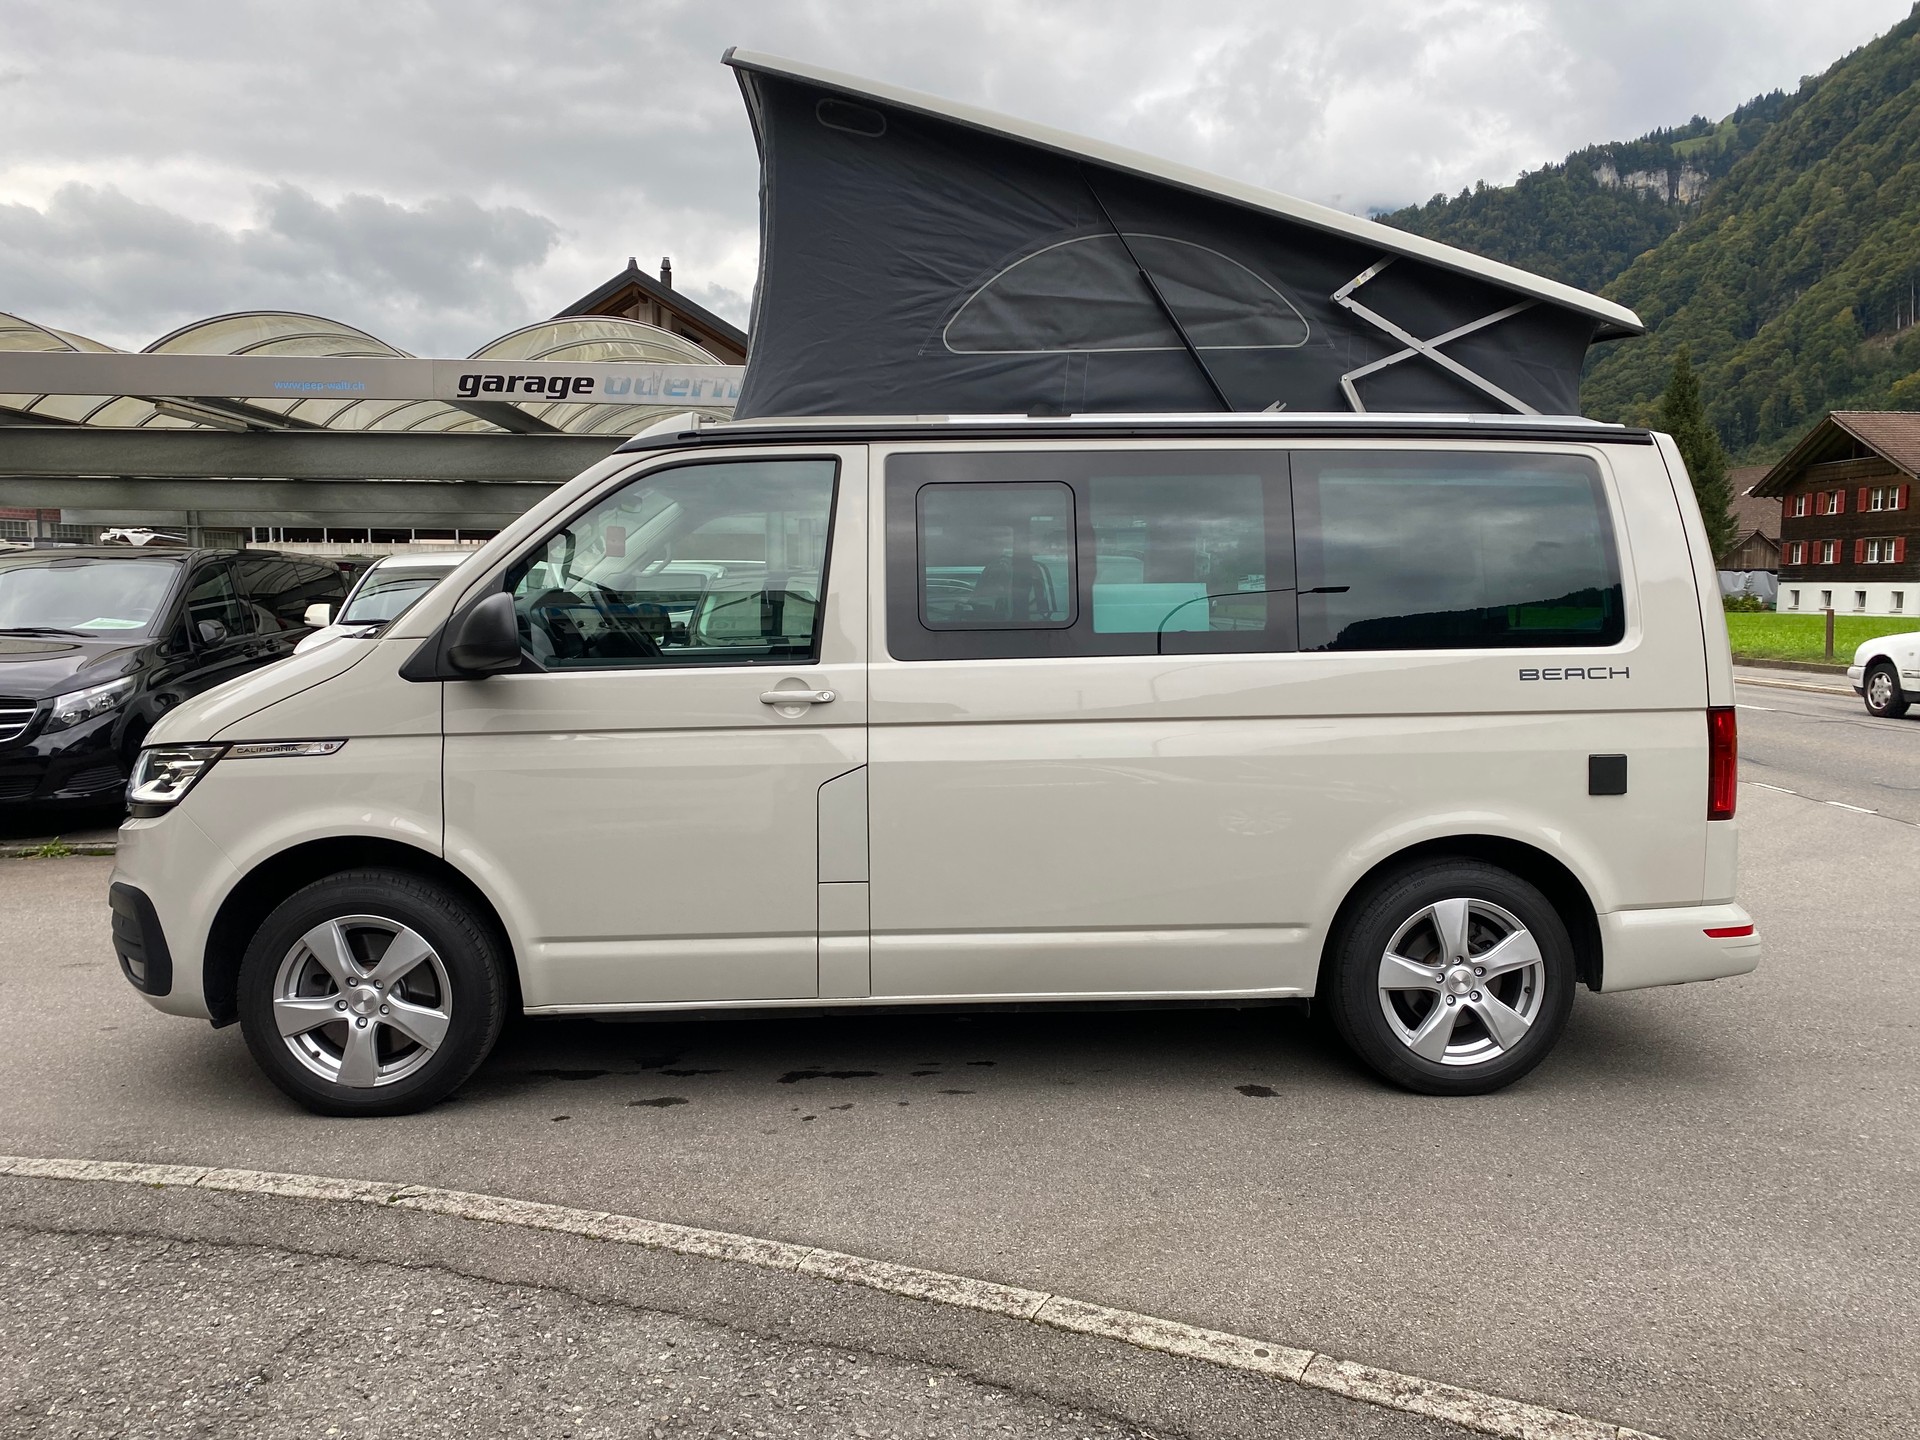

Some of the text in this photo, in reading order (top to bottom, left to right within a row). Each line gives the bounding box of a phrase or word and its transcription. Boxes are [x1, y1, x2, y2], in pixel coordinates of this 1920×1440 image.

[457, 374, 594, 400] garage
[1519, 666, 1630, 681] BEACH
[236, 745, 299, 755] CALIFORNIA
[1412, 880, 1426, 890] 200
